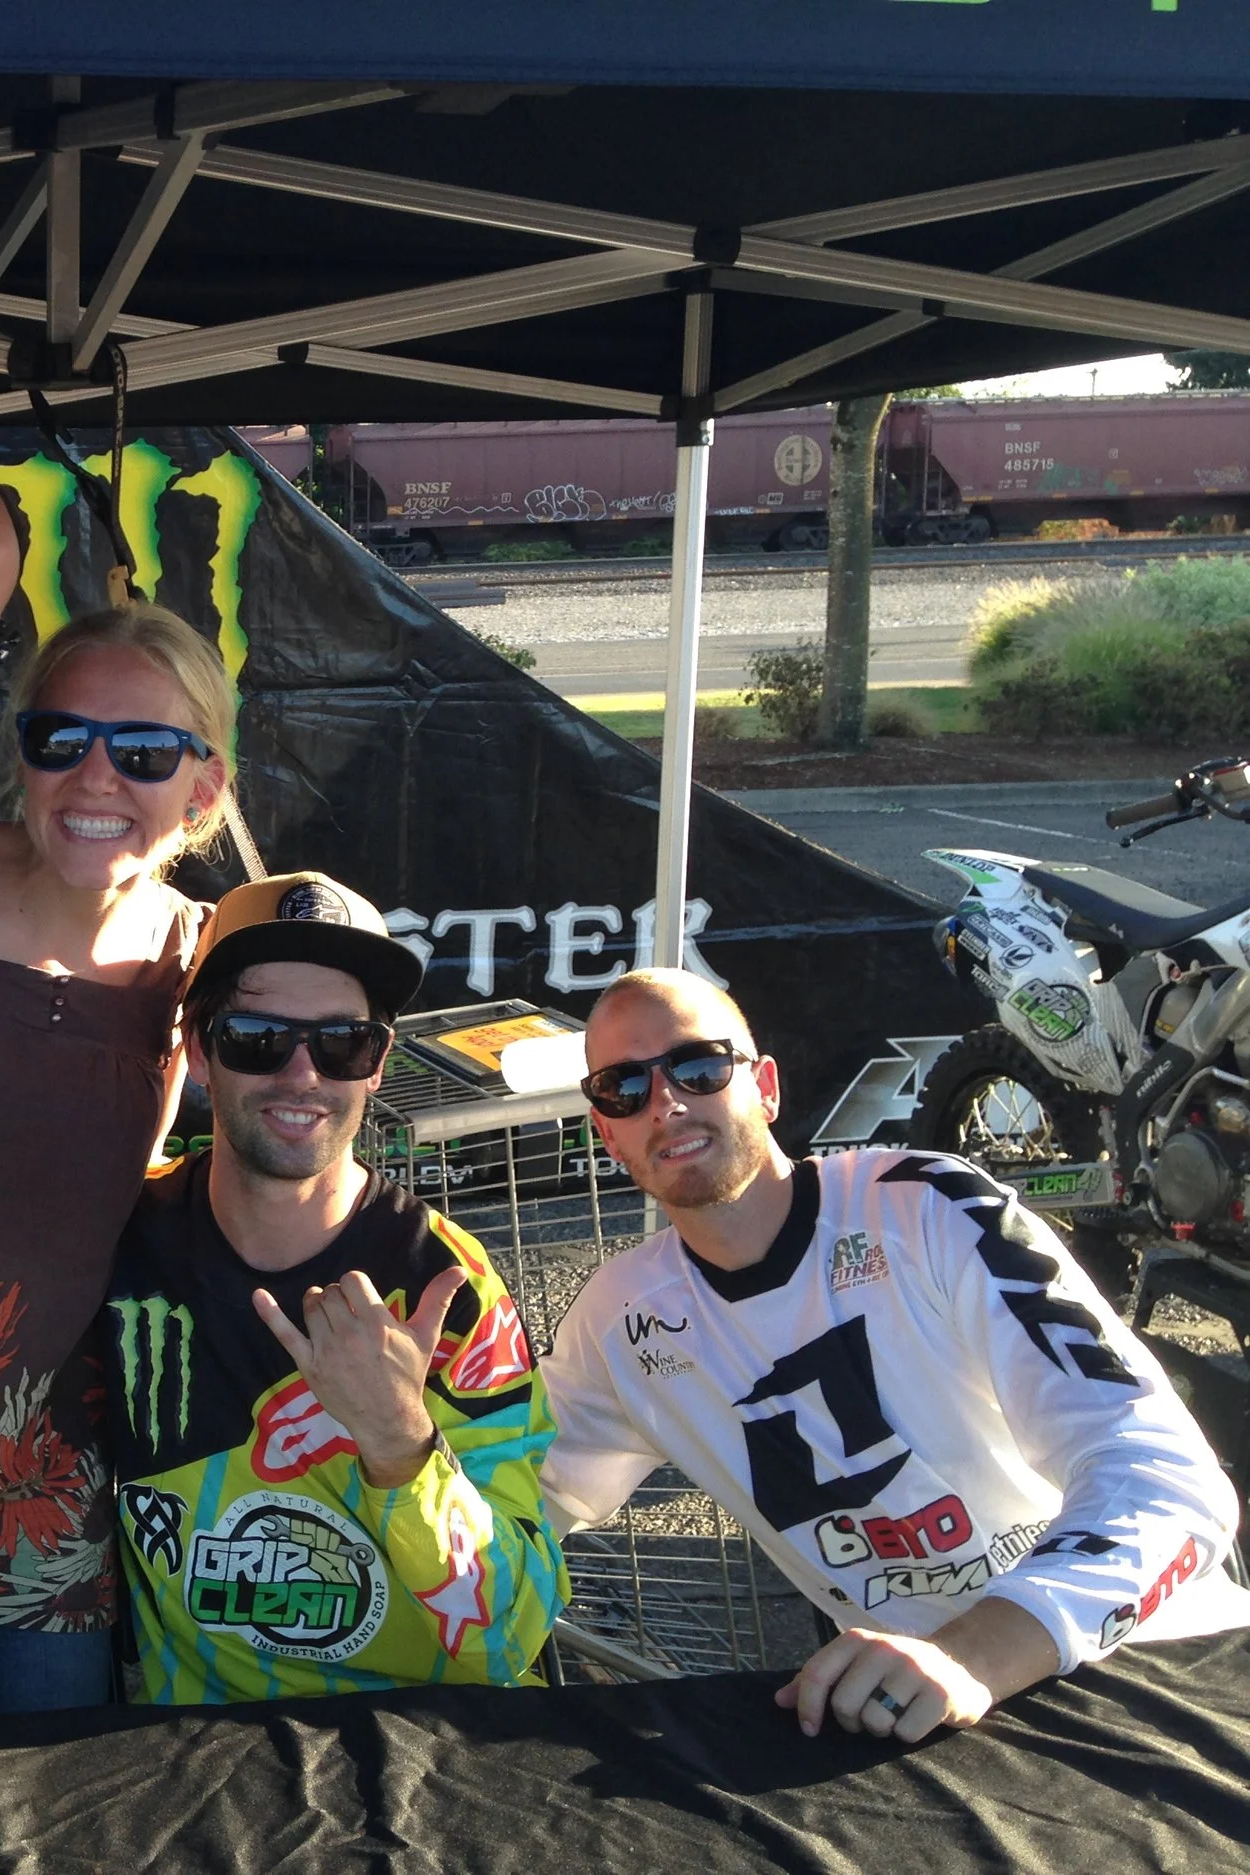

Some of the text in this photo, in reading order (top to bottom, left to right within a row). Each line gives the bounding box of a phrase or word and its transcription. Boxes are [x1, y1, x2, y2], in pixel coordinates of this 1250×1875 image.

[1004, 459, 1054, 472] 485715
[1005, 442, 1041, 454] BNSF
[404, 482, 452, 495] BNSF
[225, 1492, 348, 1532] ALL NATURAL
[193, 1536, 311, 1584] GRIP
[189, 1576, 360, 1628] CLEAN
[251, 1580, 387, 1661] INDUSTRIAL HAND SOAP
